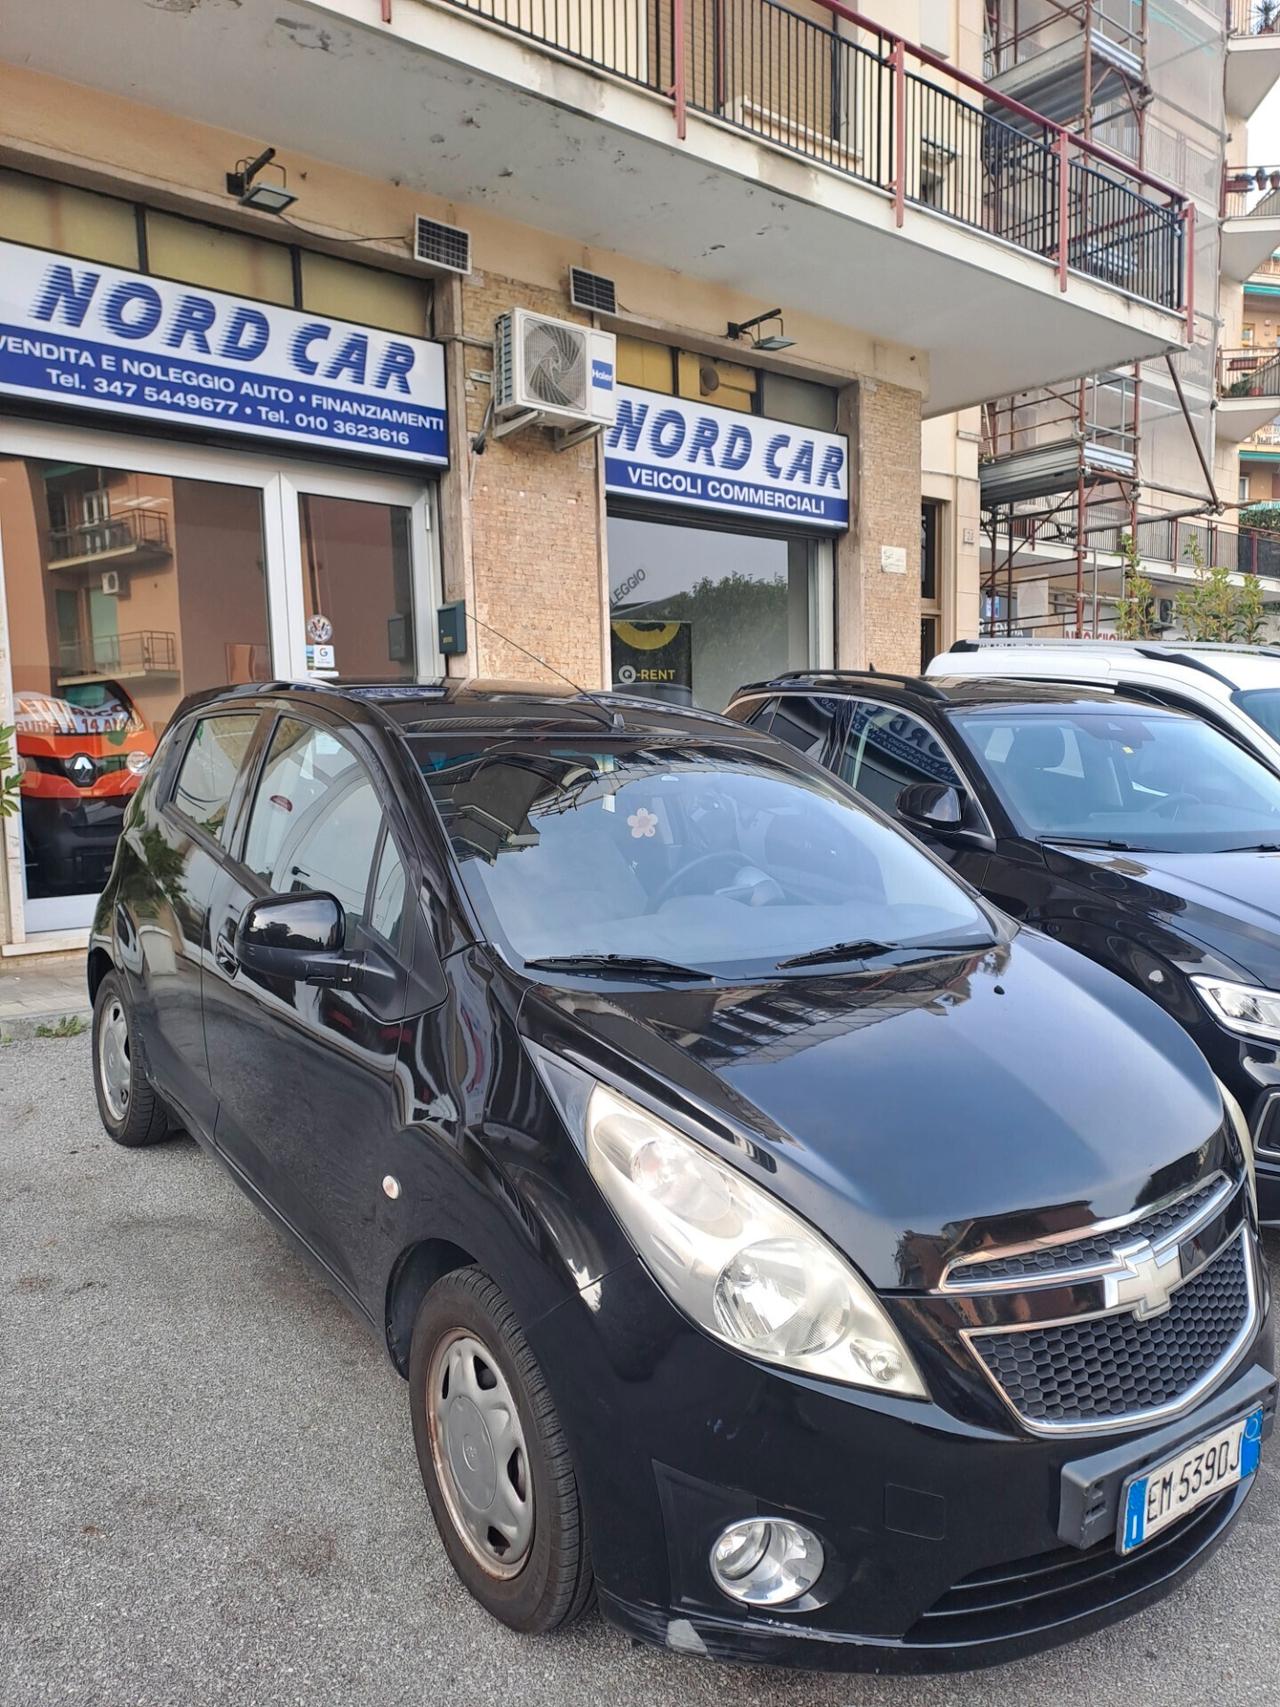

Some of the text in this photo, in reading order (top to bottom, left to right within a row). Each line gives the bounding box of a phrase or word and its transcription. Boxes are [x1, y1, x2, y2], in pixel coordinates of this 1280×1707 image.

[28, 264, 417, 394] NORD CAR
[46, 368, 410, 446] Tel. 347 5449677 Tel. 010 3623616
[101, 354, 116, 371] E
[122, 358, 236, 392] NOLEGGIO
[240, 381, 294, 403] AUTO
[311, 394, 445, 432] FINANZIAMENTI
[592, 369, 613, 382] Haier
[605, 399, 845, 490] NORD CAR
[627, 466, 825, 515] VEICOLI COMMERCIALI
[1147, 1432, 1243, 1523] EM 539DJ
